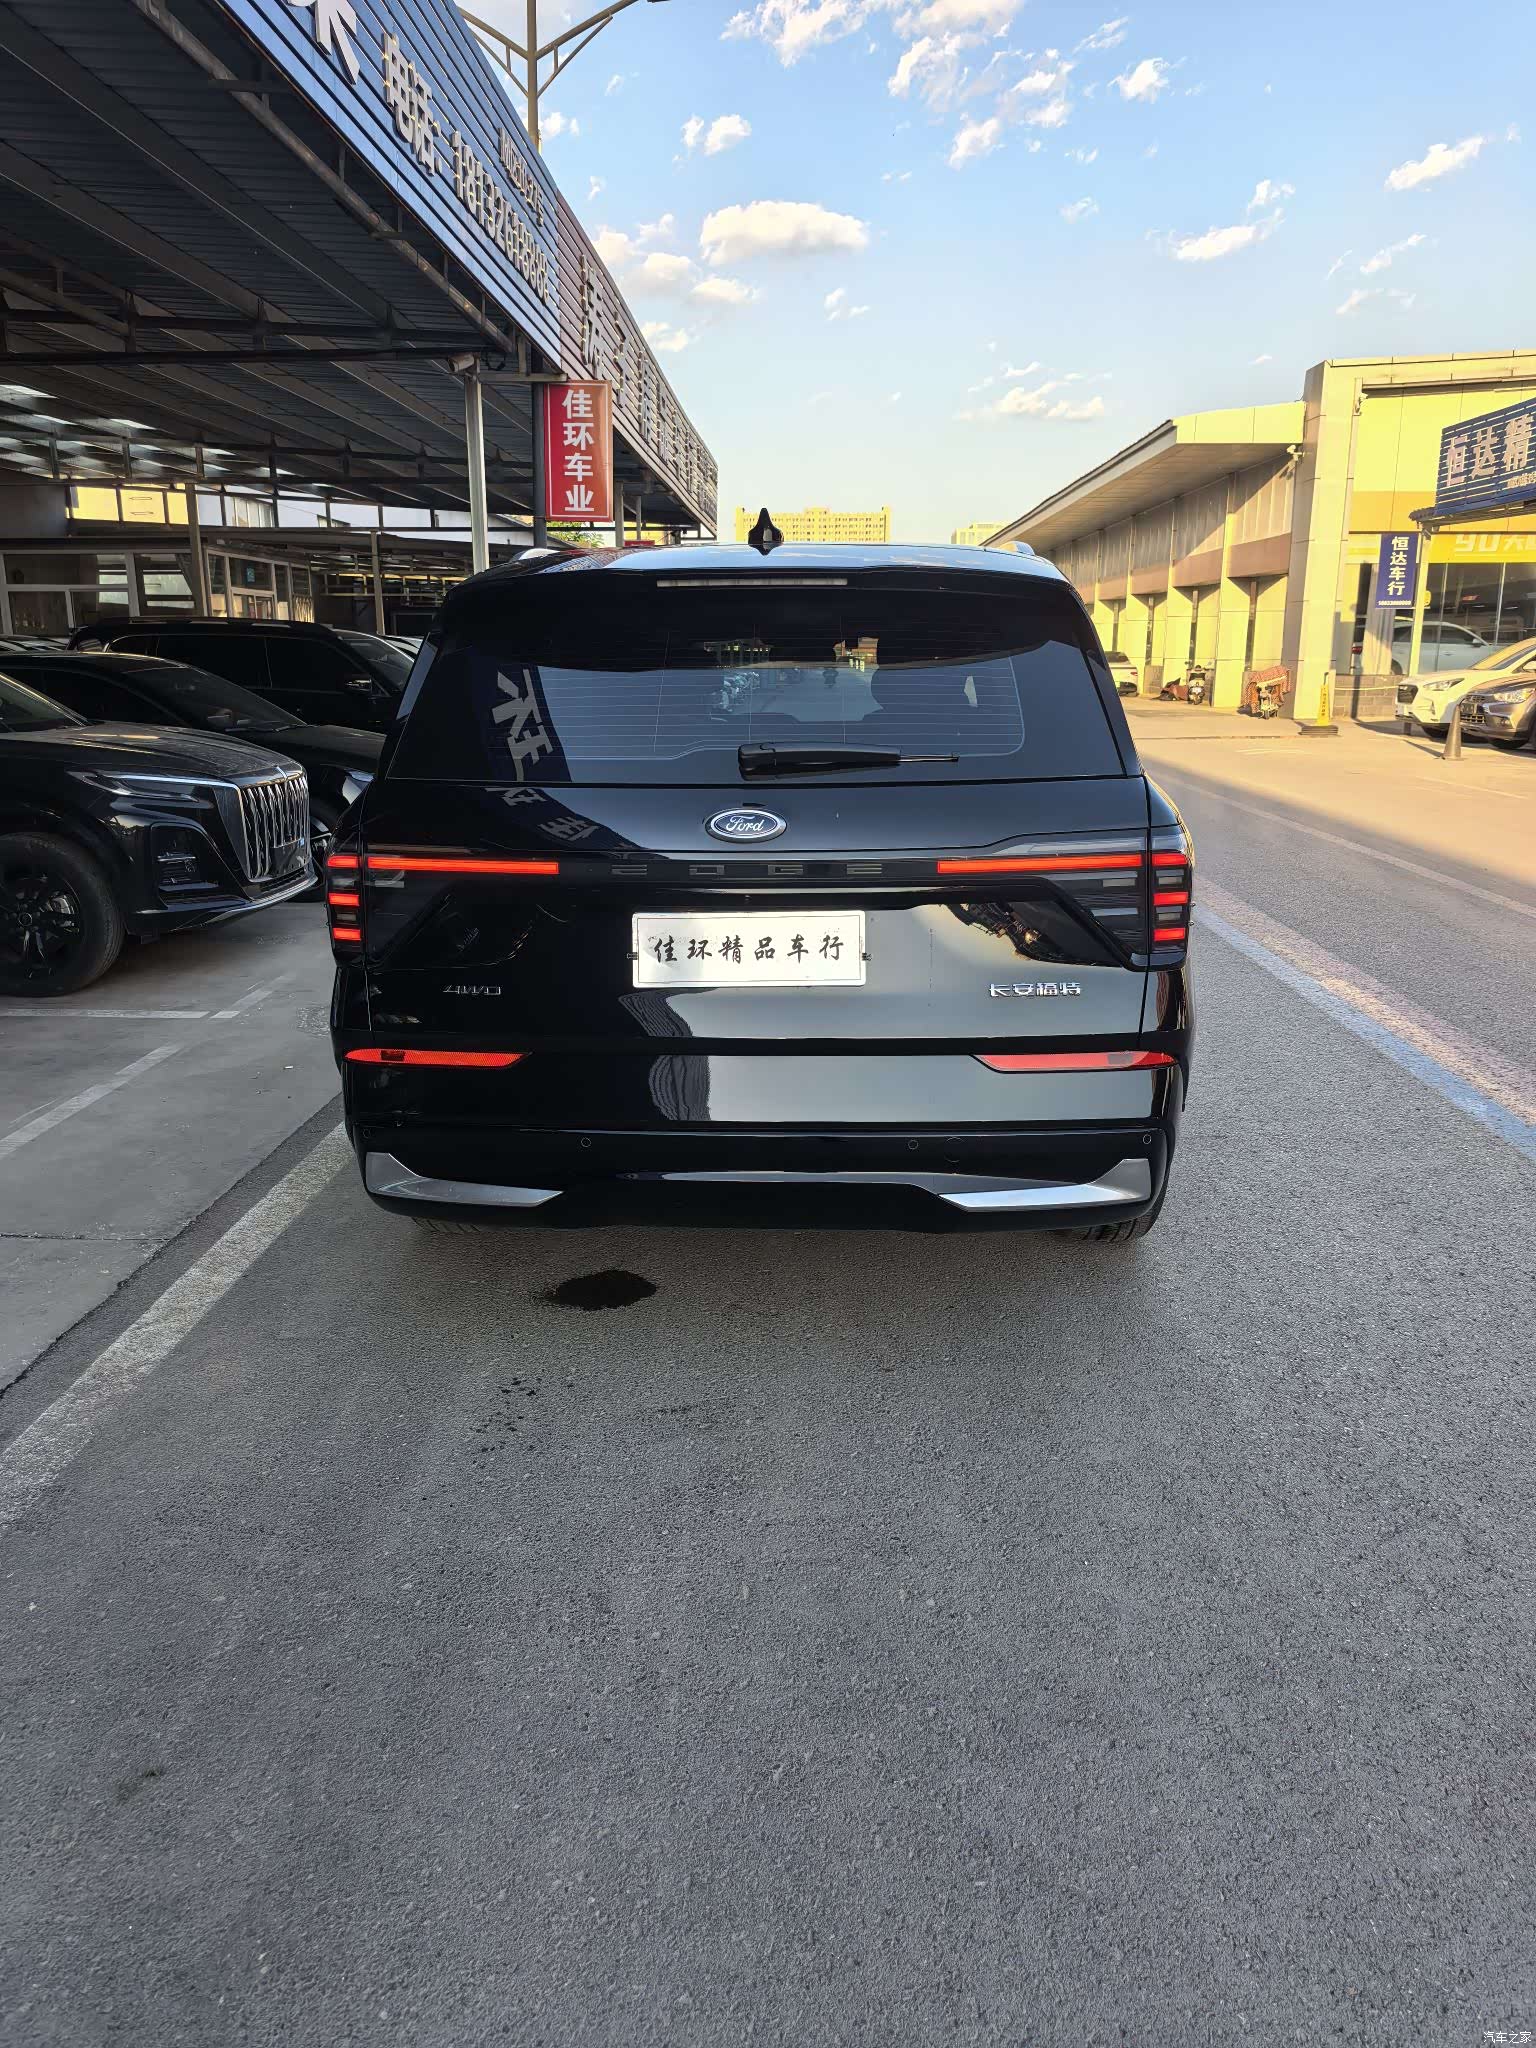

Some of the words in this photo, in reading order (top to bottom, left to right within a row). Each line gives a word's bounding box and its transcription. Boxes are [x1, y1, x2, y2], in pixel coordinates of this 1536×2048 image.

[561, 388, 595, 512] 佳环车业
[1446, 413, 1535, 487] 恒达精
[1386, 535, 1410, 596] 恒达车行
[726, 815, 765, 832] Ford
[653, 933, 845, 965] 佳环精品车行
[989, 981, 1082, 998] 长安福特
